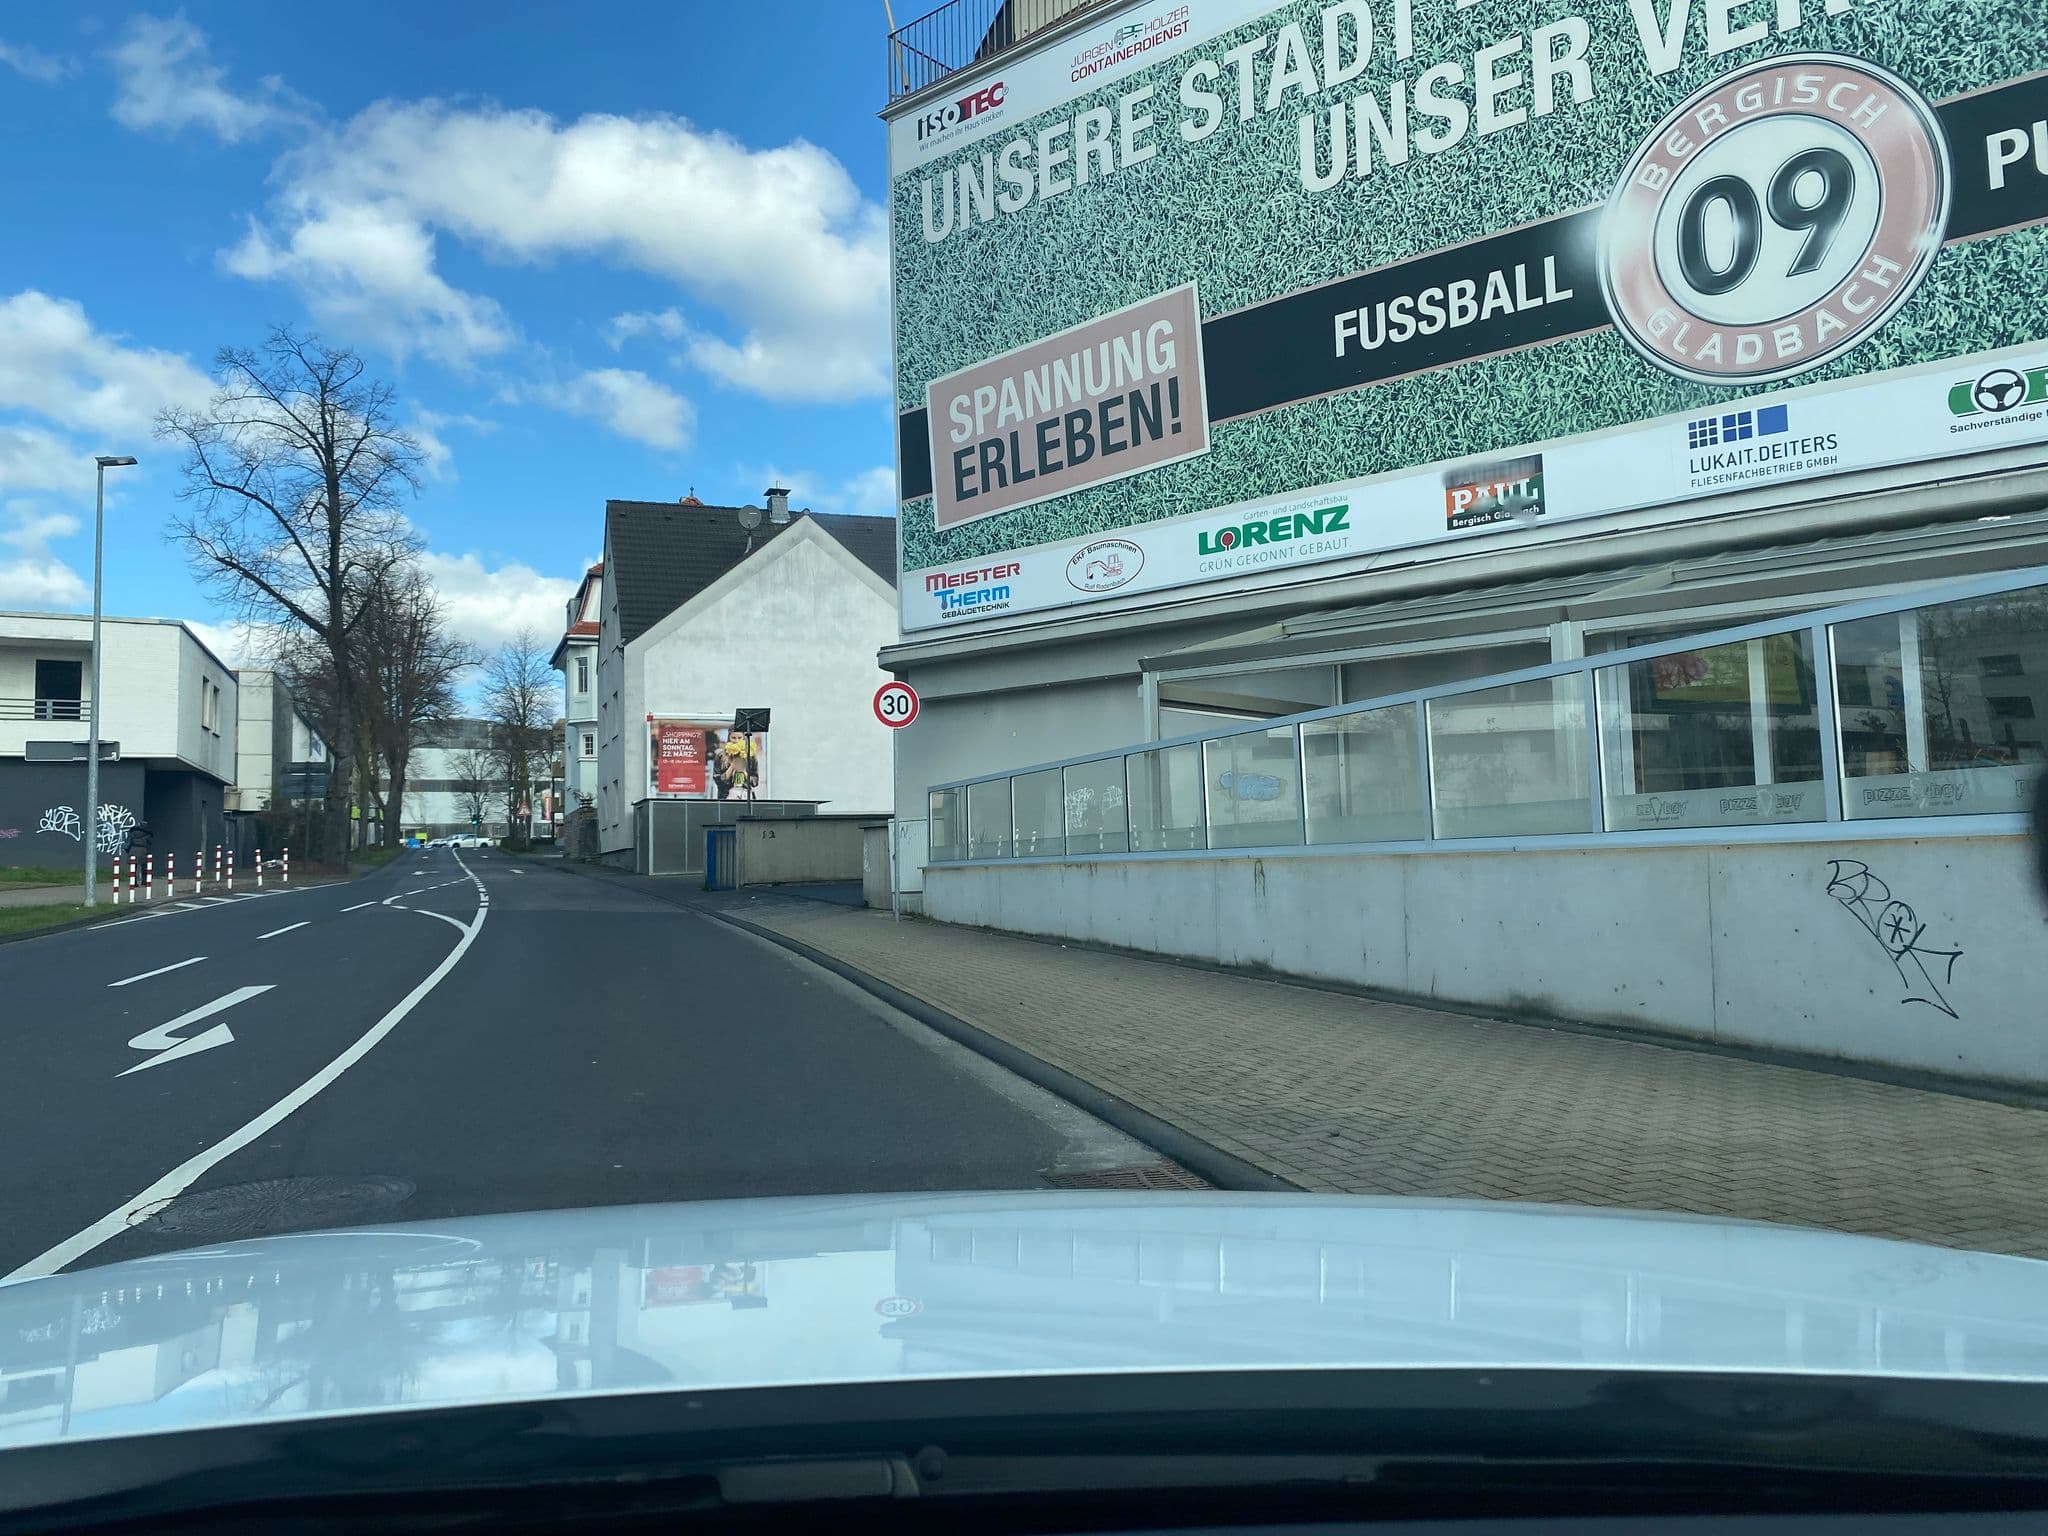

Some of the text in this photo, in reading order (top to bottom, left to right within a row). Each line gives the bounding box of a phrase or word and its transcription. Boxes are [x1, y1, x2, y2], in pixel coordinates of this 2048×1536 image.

[1071, 20, 1190, 83] CONTAINERDIENST
[1301, 16, 1597, 193] UNSER
[930, 131, 955, 148] machen
[964, 121, 981, 132] Haus
[981, 110, 1005, 125] trocken
[1637, 75, 1888, 192] BERGISCH
[921, 84, 1157, 244] UNSERE
[1678, 147, 1857, 296] 09
[1334, 255, 1574, 358] FUSSBALL
[1646, 254, 1902, 366] GLADBACH
[949, 319, 1178, 444] SPANNUNG
[953, 376, 1183, 502] ERLEBEN!
[1950, 410, 2043, 434] Sachverständige
[1690, 433, 1838, 474] LUKAIT.DEITERS
[1691, 455, 1838, 488] FLIESENFACHBETRIEB GMBH
[1243, 495, 1348, 521] Garten- und Landschaftsbau
[1452, 512, 1492, 527] Bergisch
[1198, 504, 1350, 556] LORENZ
[1072, 541, 1137, 566] EKF Baumaschinen
[1236, 546, 1296, 567] GEKONNT
[925, 562, 1021, 593] MEISTER
[934, 585, 1010, 611] THERM
[941, 601, 1011, 620] GEBÄUDETECHNIK
[883, 695, 909, 715] 30
